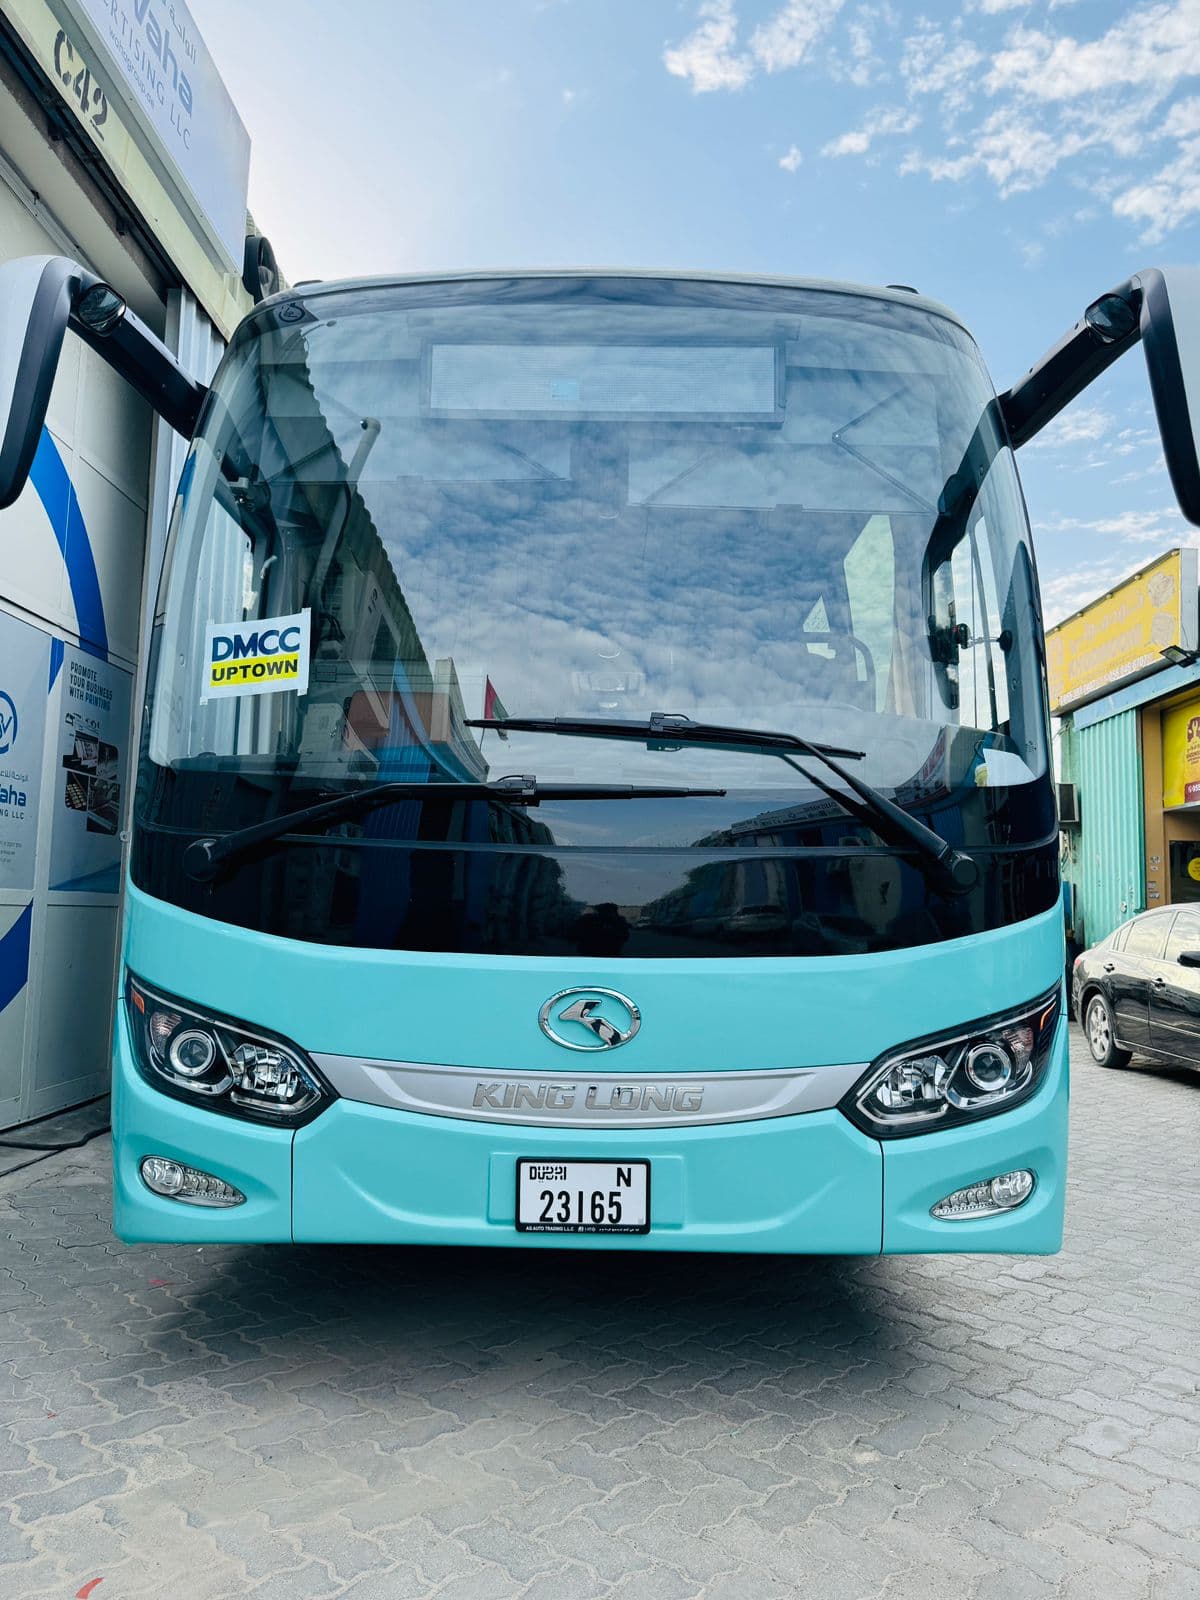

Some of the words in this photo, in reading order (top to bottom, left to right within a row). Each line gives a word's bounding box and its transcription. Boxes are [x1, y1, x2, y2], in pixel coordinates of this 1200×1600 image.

[54, 29, 108, 141] C42
[169, 103, 191, 151] LLC
[211, 626, 301, 663] DMCC
[70, 661, 97, 682] PROMOTE
[211, 658, 298, 682] UPTOWN
[69, 673, 85, 690] YOUR
[86, 680, 113, 700] BUSINESS
[69, 686, 84, 701] WITH
[0, 784, 27, 807] aha
[12, 811, 25, 820] LLC
[472, 1081, 577, 1110] KING
[584, 1084, 705, 1112] LONG
[616, 1167, 632, 1188] N
[539, 1189, 622, 1224] 23165
